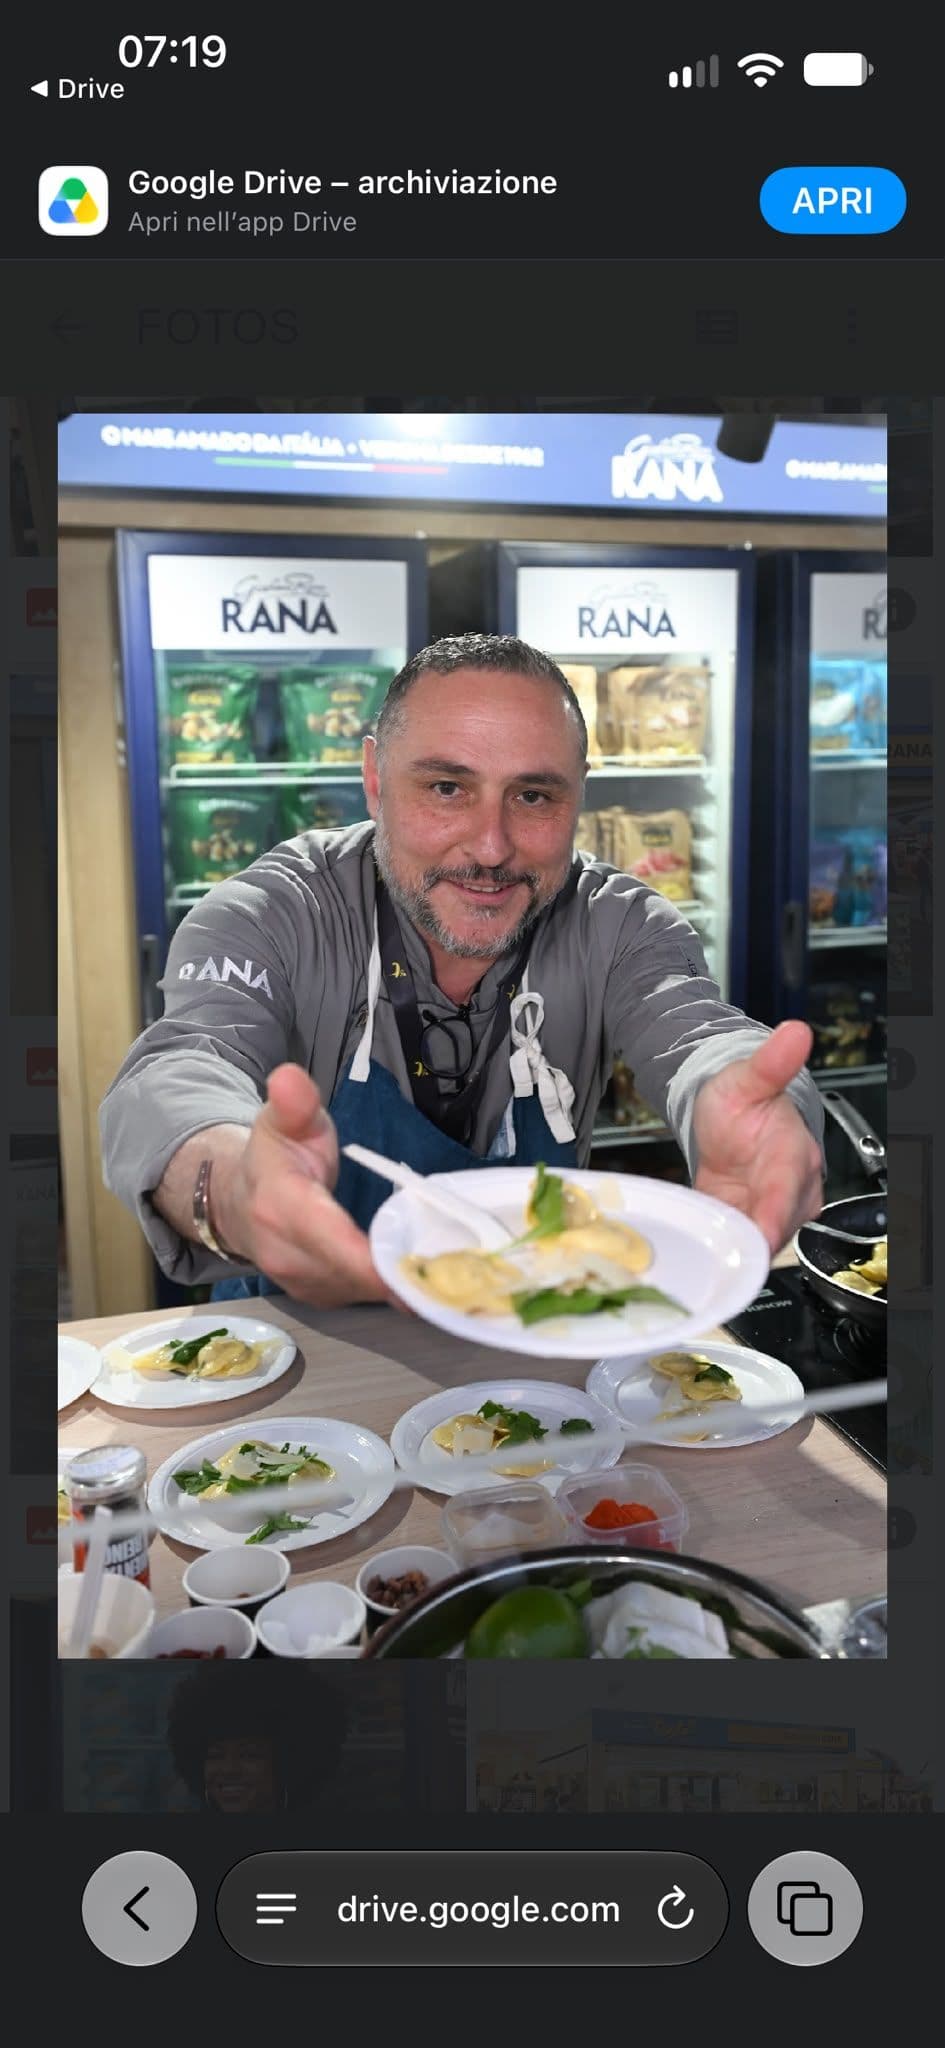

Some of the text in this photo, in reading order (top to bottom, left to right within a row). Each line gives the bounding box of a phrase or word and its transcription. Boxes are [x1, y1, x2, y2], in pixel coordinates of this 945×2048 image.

[118, 34, 227, 68] 07:19
[58, 77, 125, 99] Drive
[128, 169, 235, 200] Google
[244, 168, 322, 195] Drive
[358, 168, 558, 195] archiviazione
[793, 187, 872, 214] APRI
[128, 210, 178, 237] Apri
[293, 210, 357, 232] Drive
[136, 310, 299, 345] FOTOS
[611, 455, 724, 503] RANA
[221, 599, 338, 634] RANA
[578, 606, 677, 638] RANA
[862, 607, 888, 641] R
[337, 1893, 620, 1929] drive.google.com
